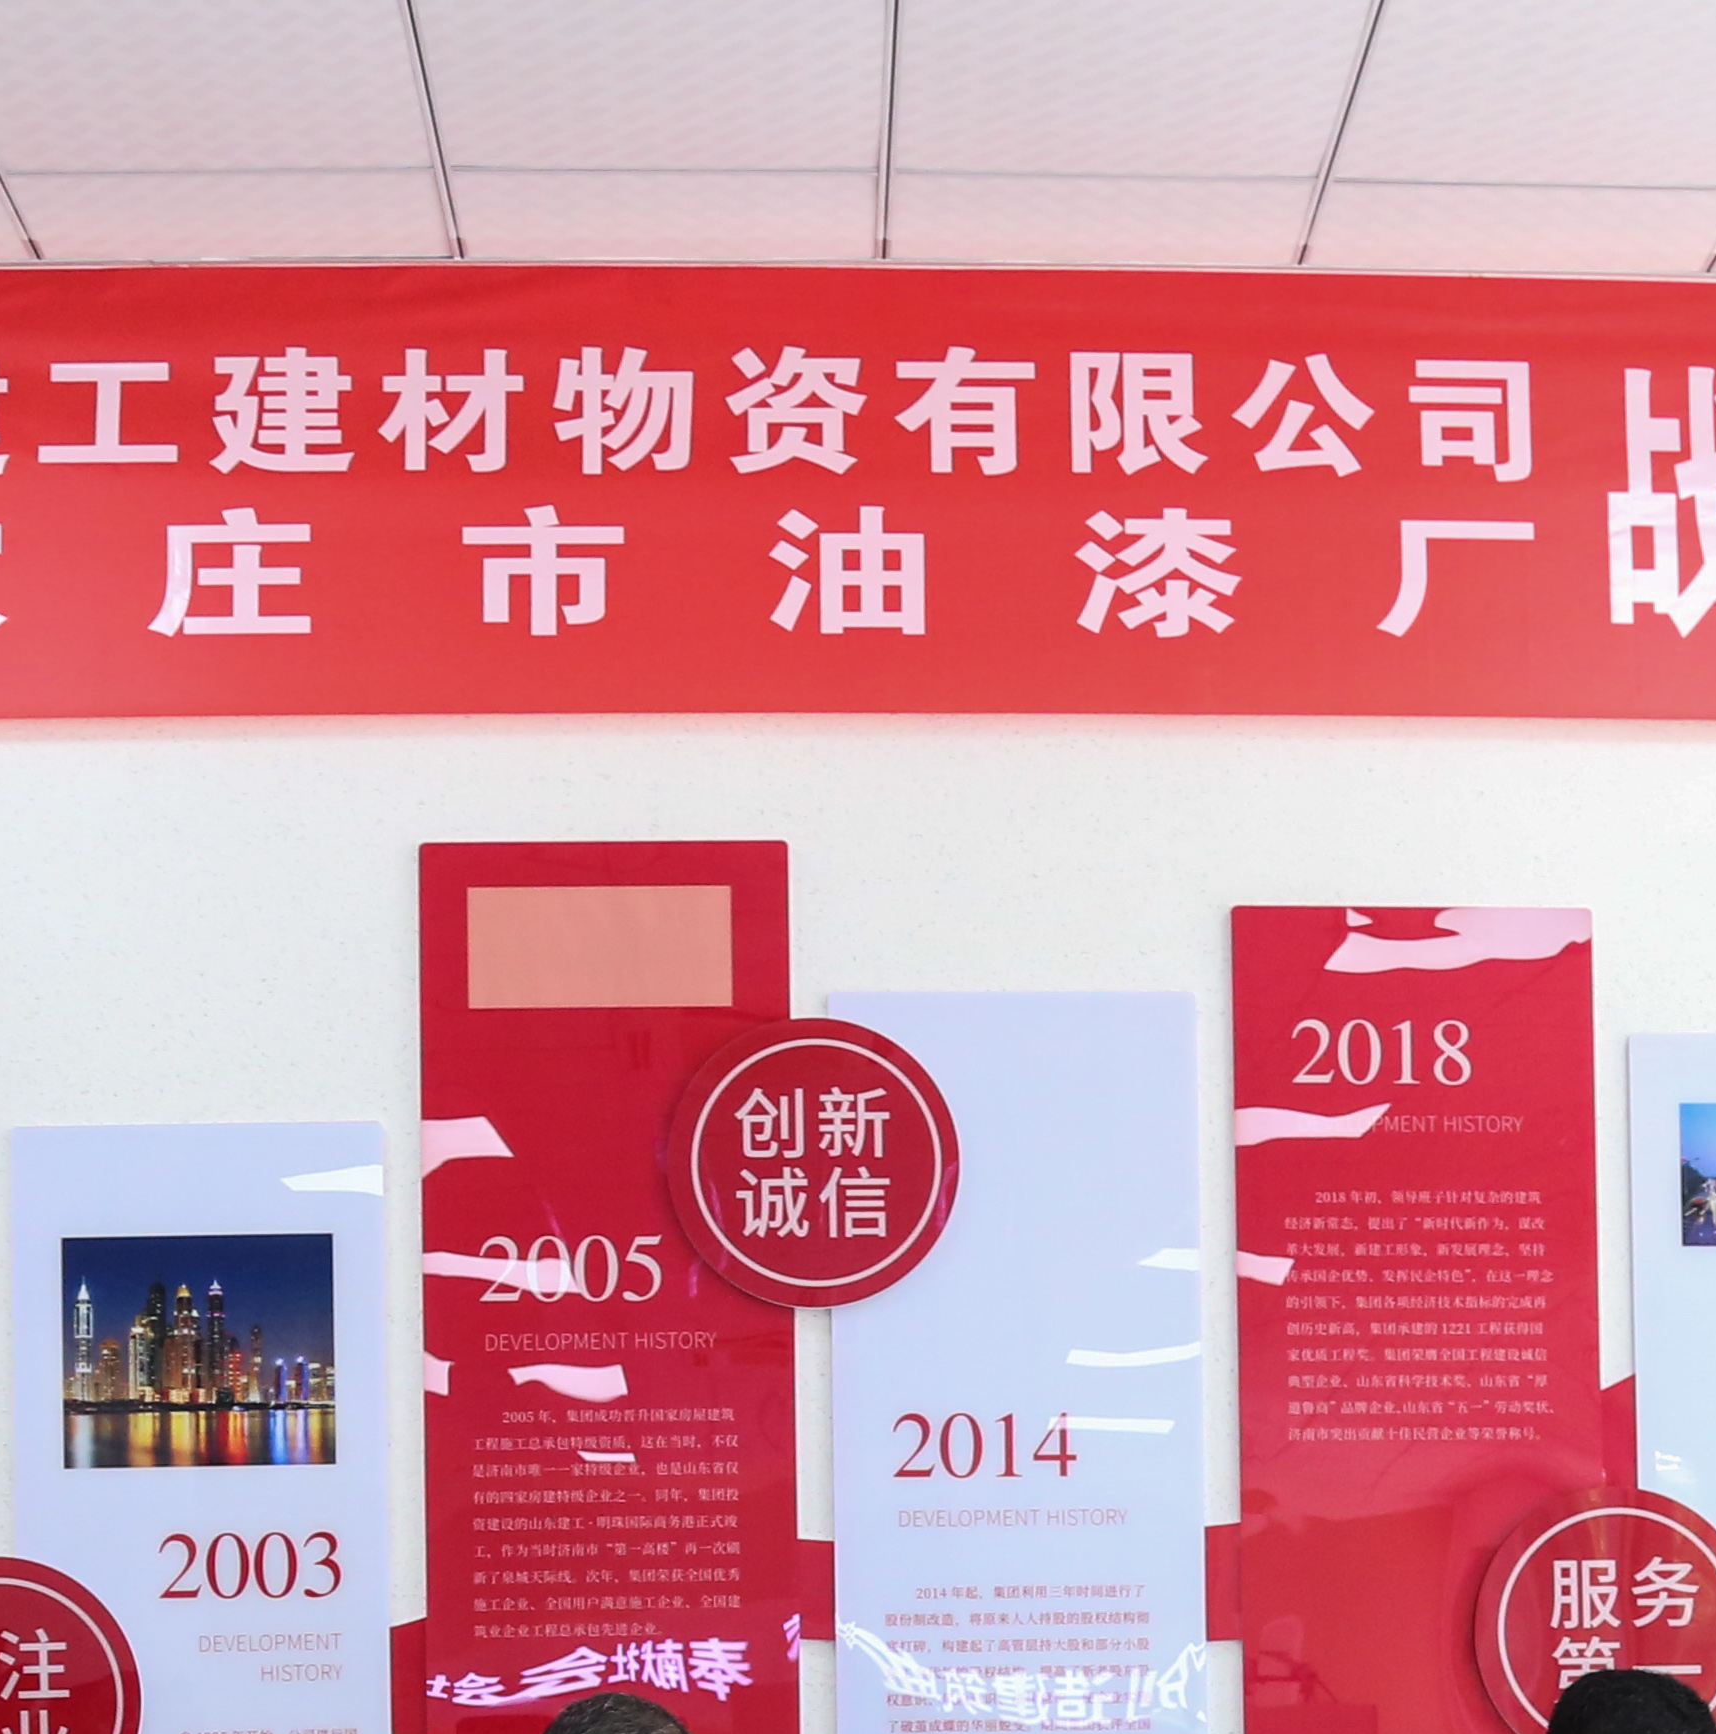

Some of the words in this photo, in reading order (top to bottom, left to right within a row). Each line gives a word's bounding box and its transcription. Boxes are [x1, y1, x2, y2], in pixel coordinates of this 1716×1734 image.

[1292, 1019, 1472, 1086] 2018
[735, 1087, 891, 1159] 创新
[1444, 1115, 1524, 1134] HISTORY
[736, 1167, 891, 1239] 诚信
[478, 1233, 663, 1304] 2005
[485, 1332, 629, 1352] DEVELOPMENT
[634, 1331, 717, 1350] HISTORY
[893, 1413, 1078, 1479] 2014
[899, 1509, 1041, 1529] DEVELOPMENT
[1048, 1509, 1128, 1527] HISTORY
[159, 1532, 342, 1600] 2003
[1551, 1557, 1700, 1629] 服务
[199, 1633, 343, 1653] DEVELOPMENT
[261, 1664, 343, 1683] HISTORY
